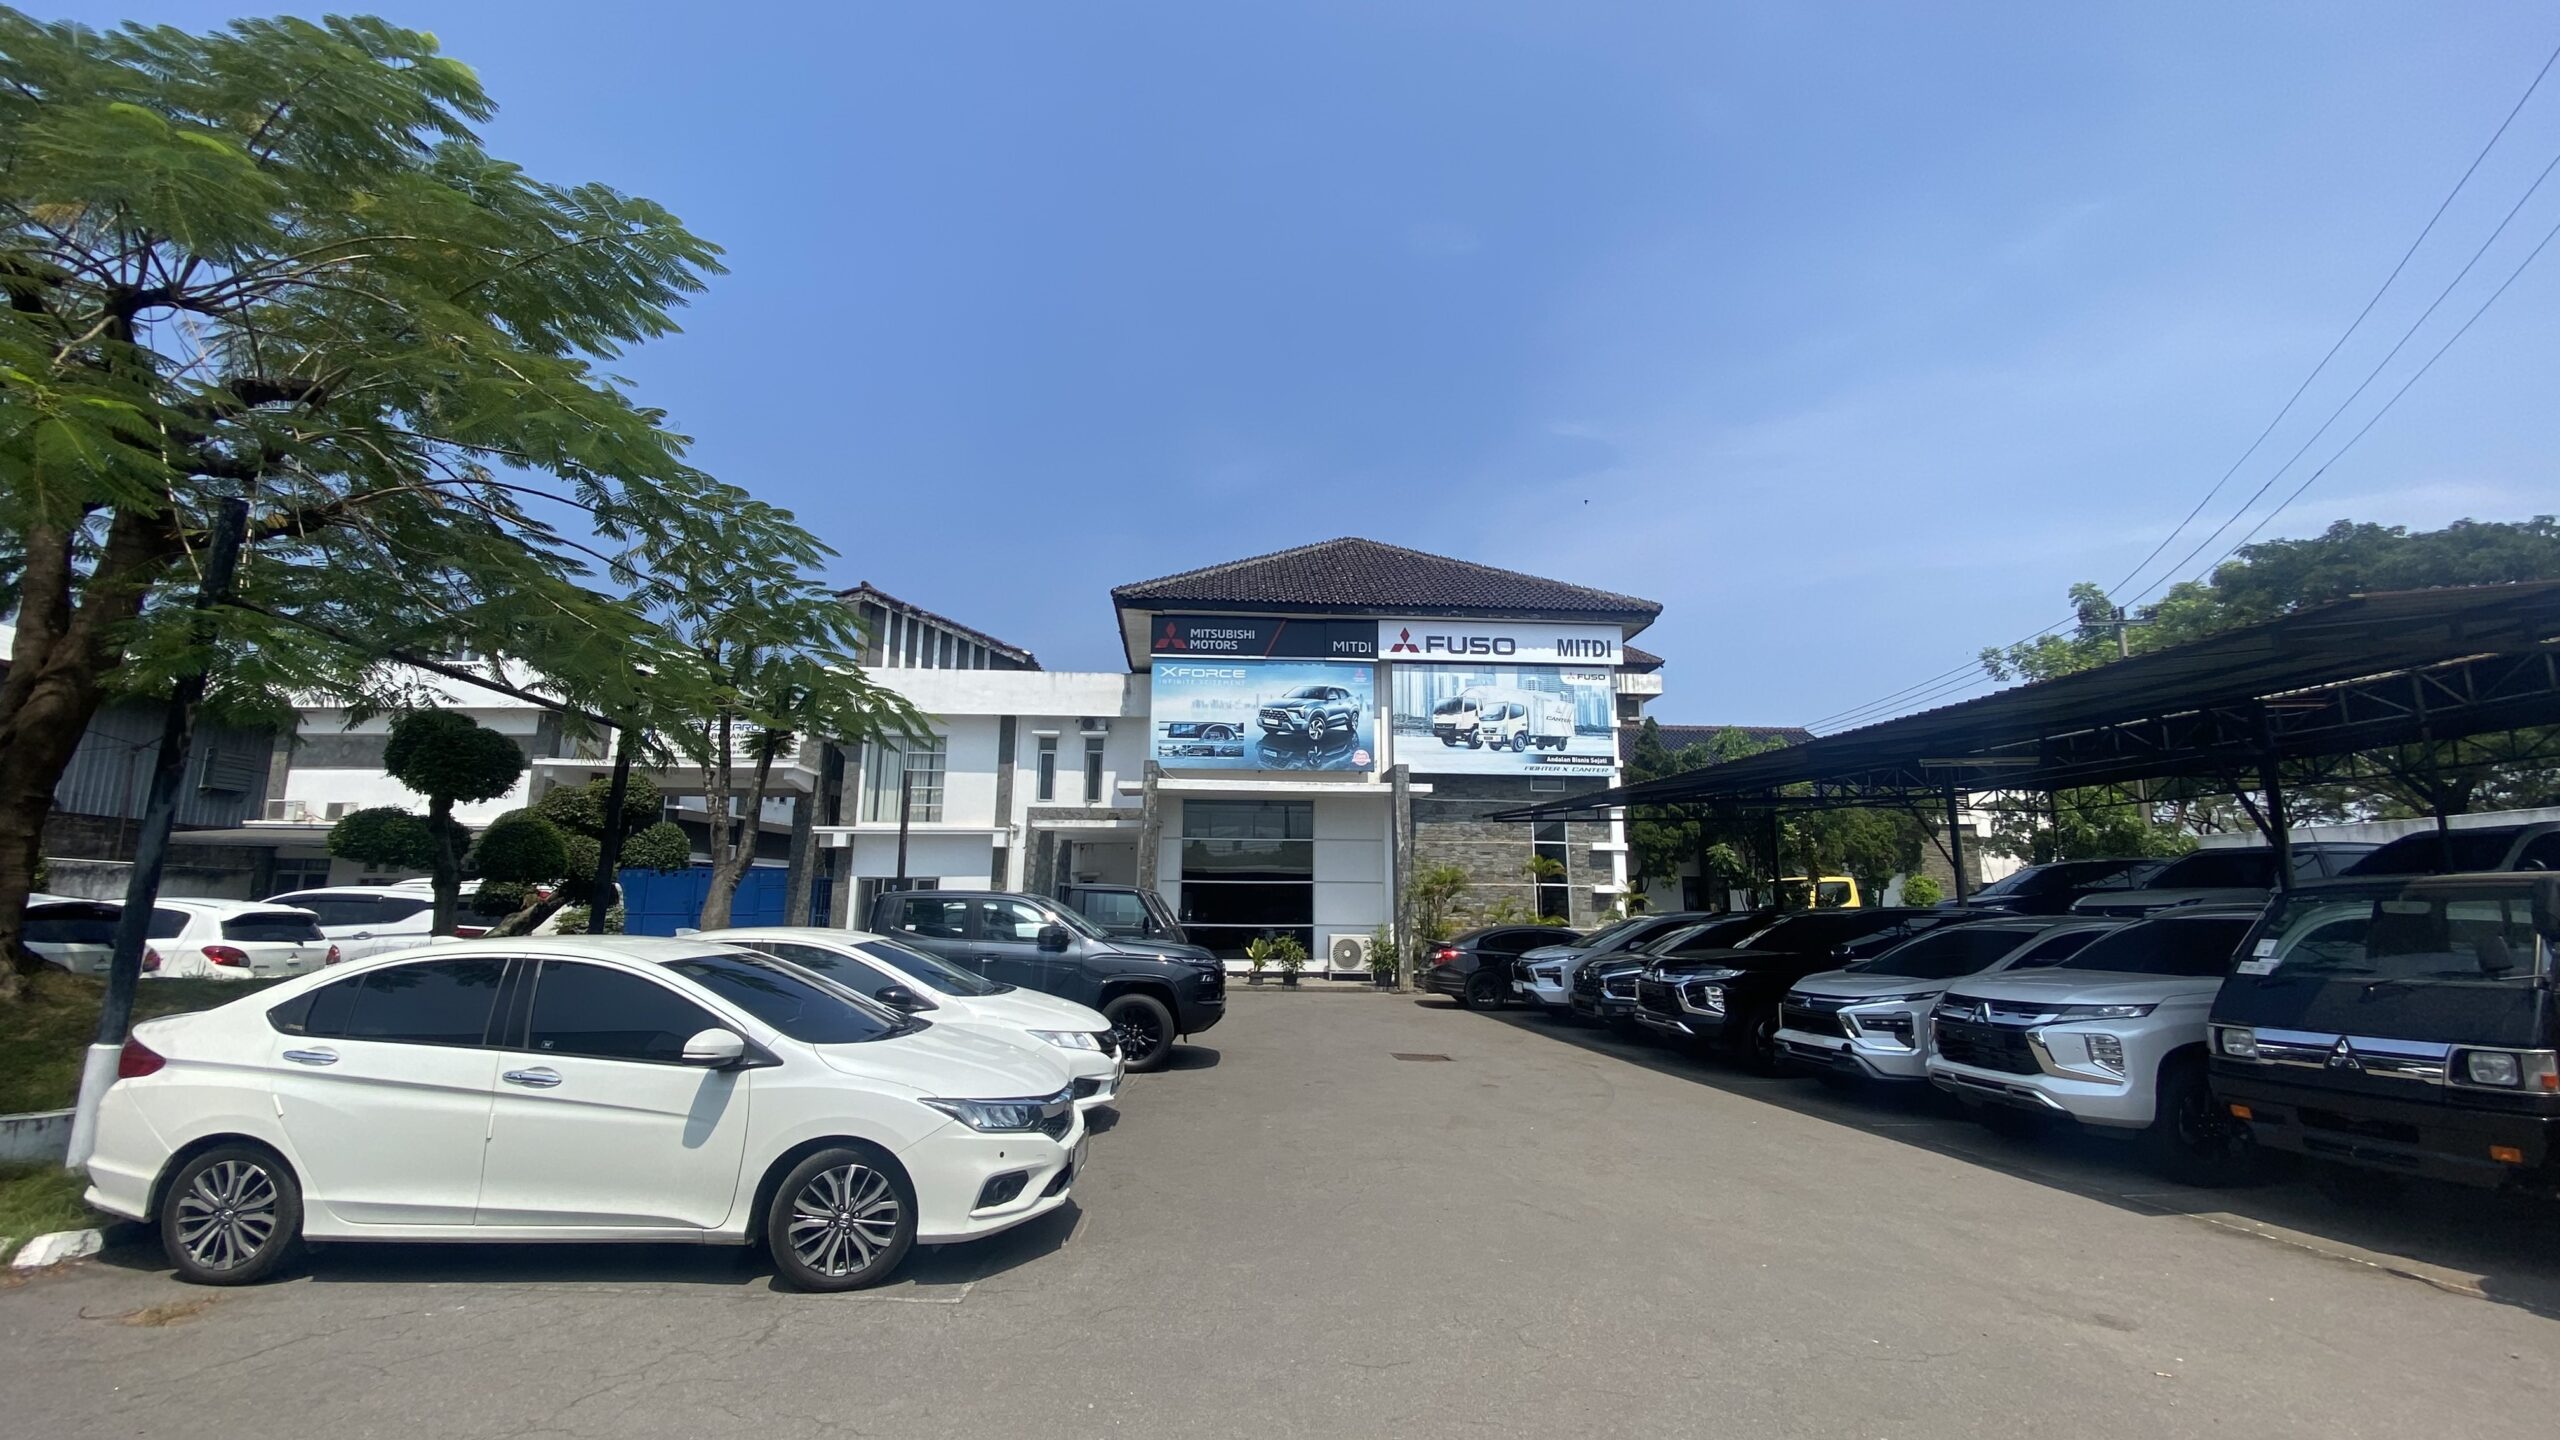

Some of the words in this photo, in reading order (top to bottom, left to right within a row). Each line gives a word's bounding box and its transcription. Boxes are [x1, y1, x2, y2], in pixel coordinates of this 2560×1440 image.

[1190, 629, 1255, 639] MITSUBISHI
[1190, 639, 1238, 650] MOTORS
[1333, 641, 1371, 653] MITDI
[1426, 635, 1516, 655] FUSO
[1557, 638, 1611, 658] MITDI
[1546, 715, 1571, 724] CANTER
[1592, 757, 1607, 765] Sejati
